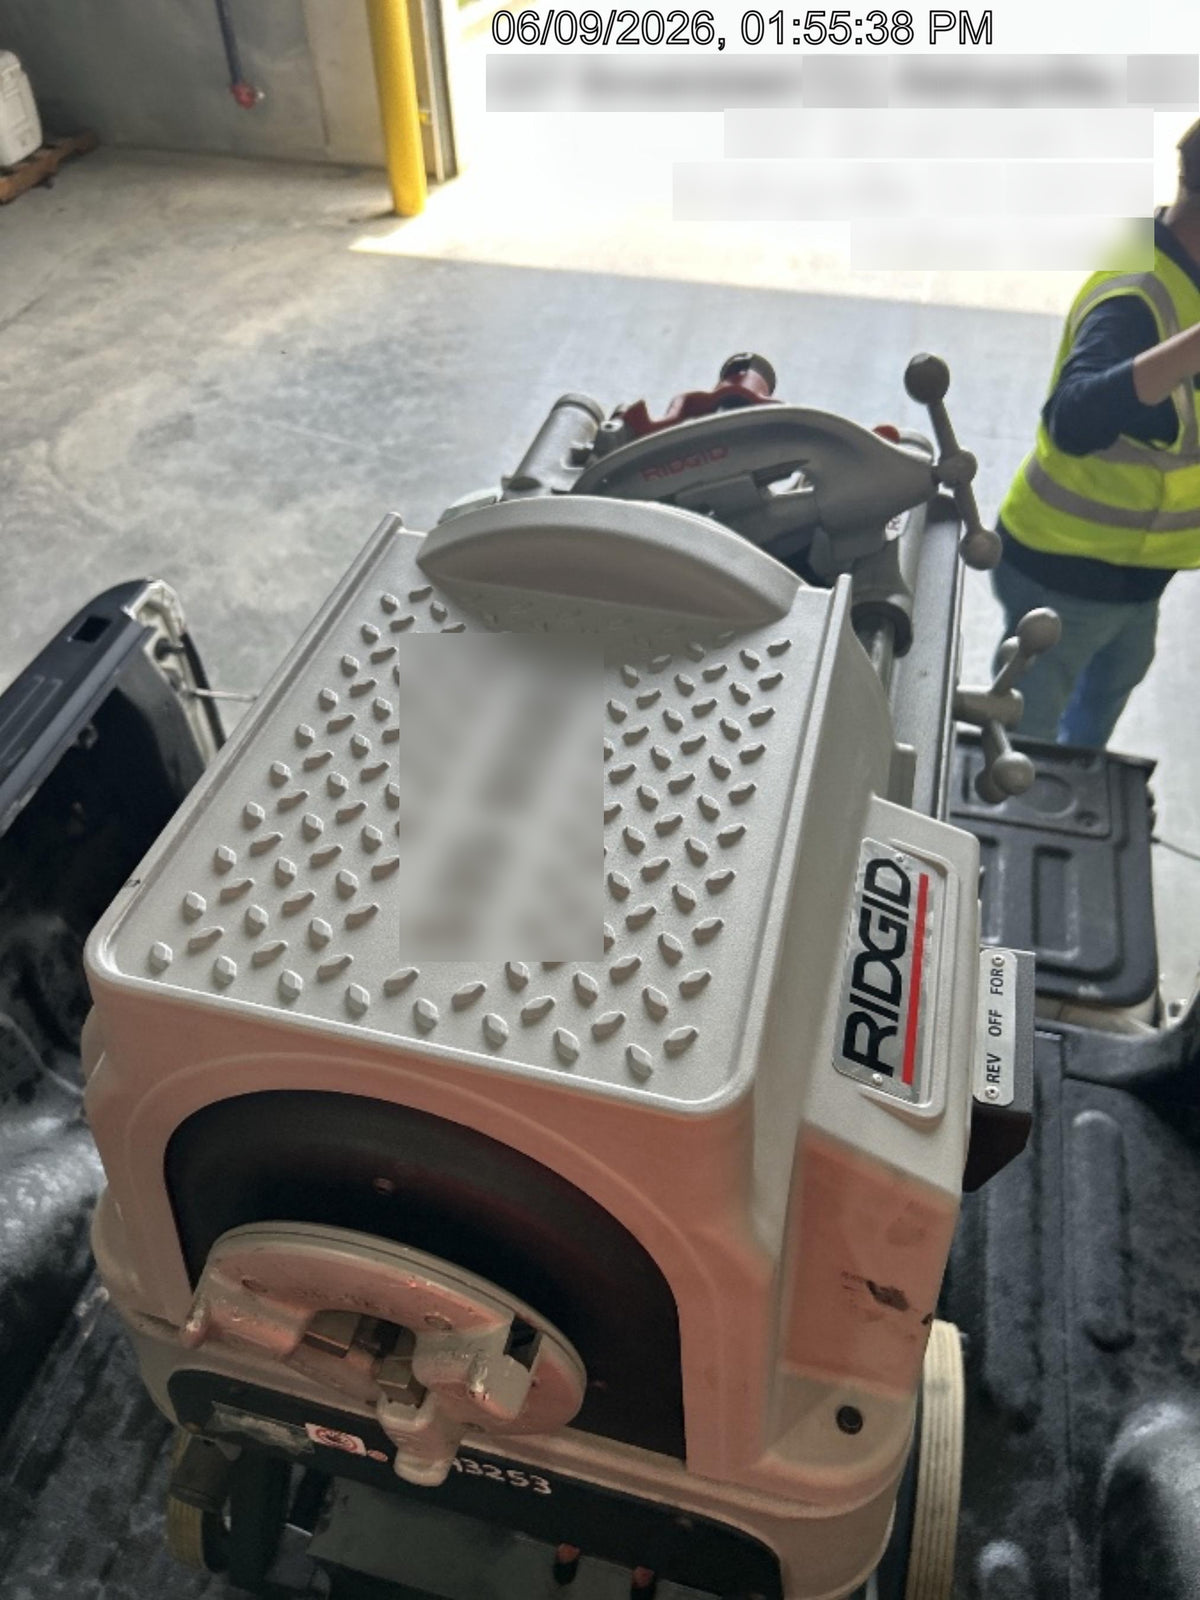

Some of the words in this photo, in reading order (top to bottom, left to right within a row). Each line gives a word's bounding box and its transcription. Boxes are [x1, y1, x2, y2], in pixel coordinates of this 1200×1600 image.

[639, 446, 729, 482] RIDGID
[842, 858, 911, 1078] RIDGID
[990, 967, 1004, 996] FOR
[988, 1009, 1003, 1037] OFF
[986, 1053, 1002, 1084] REV
